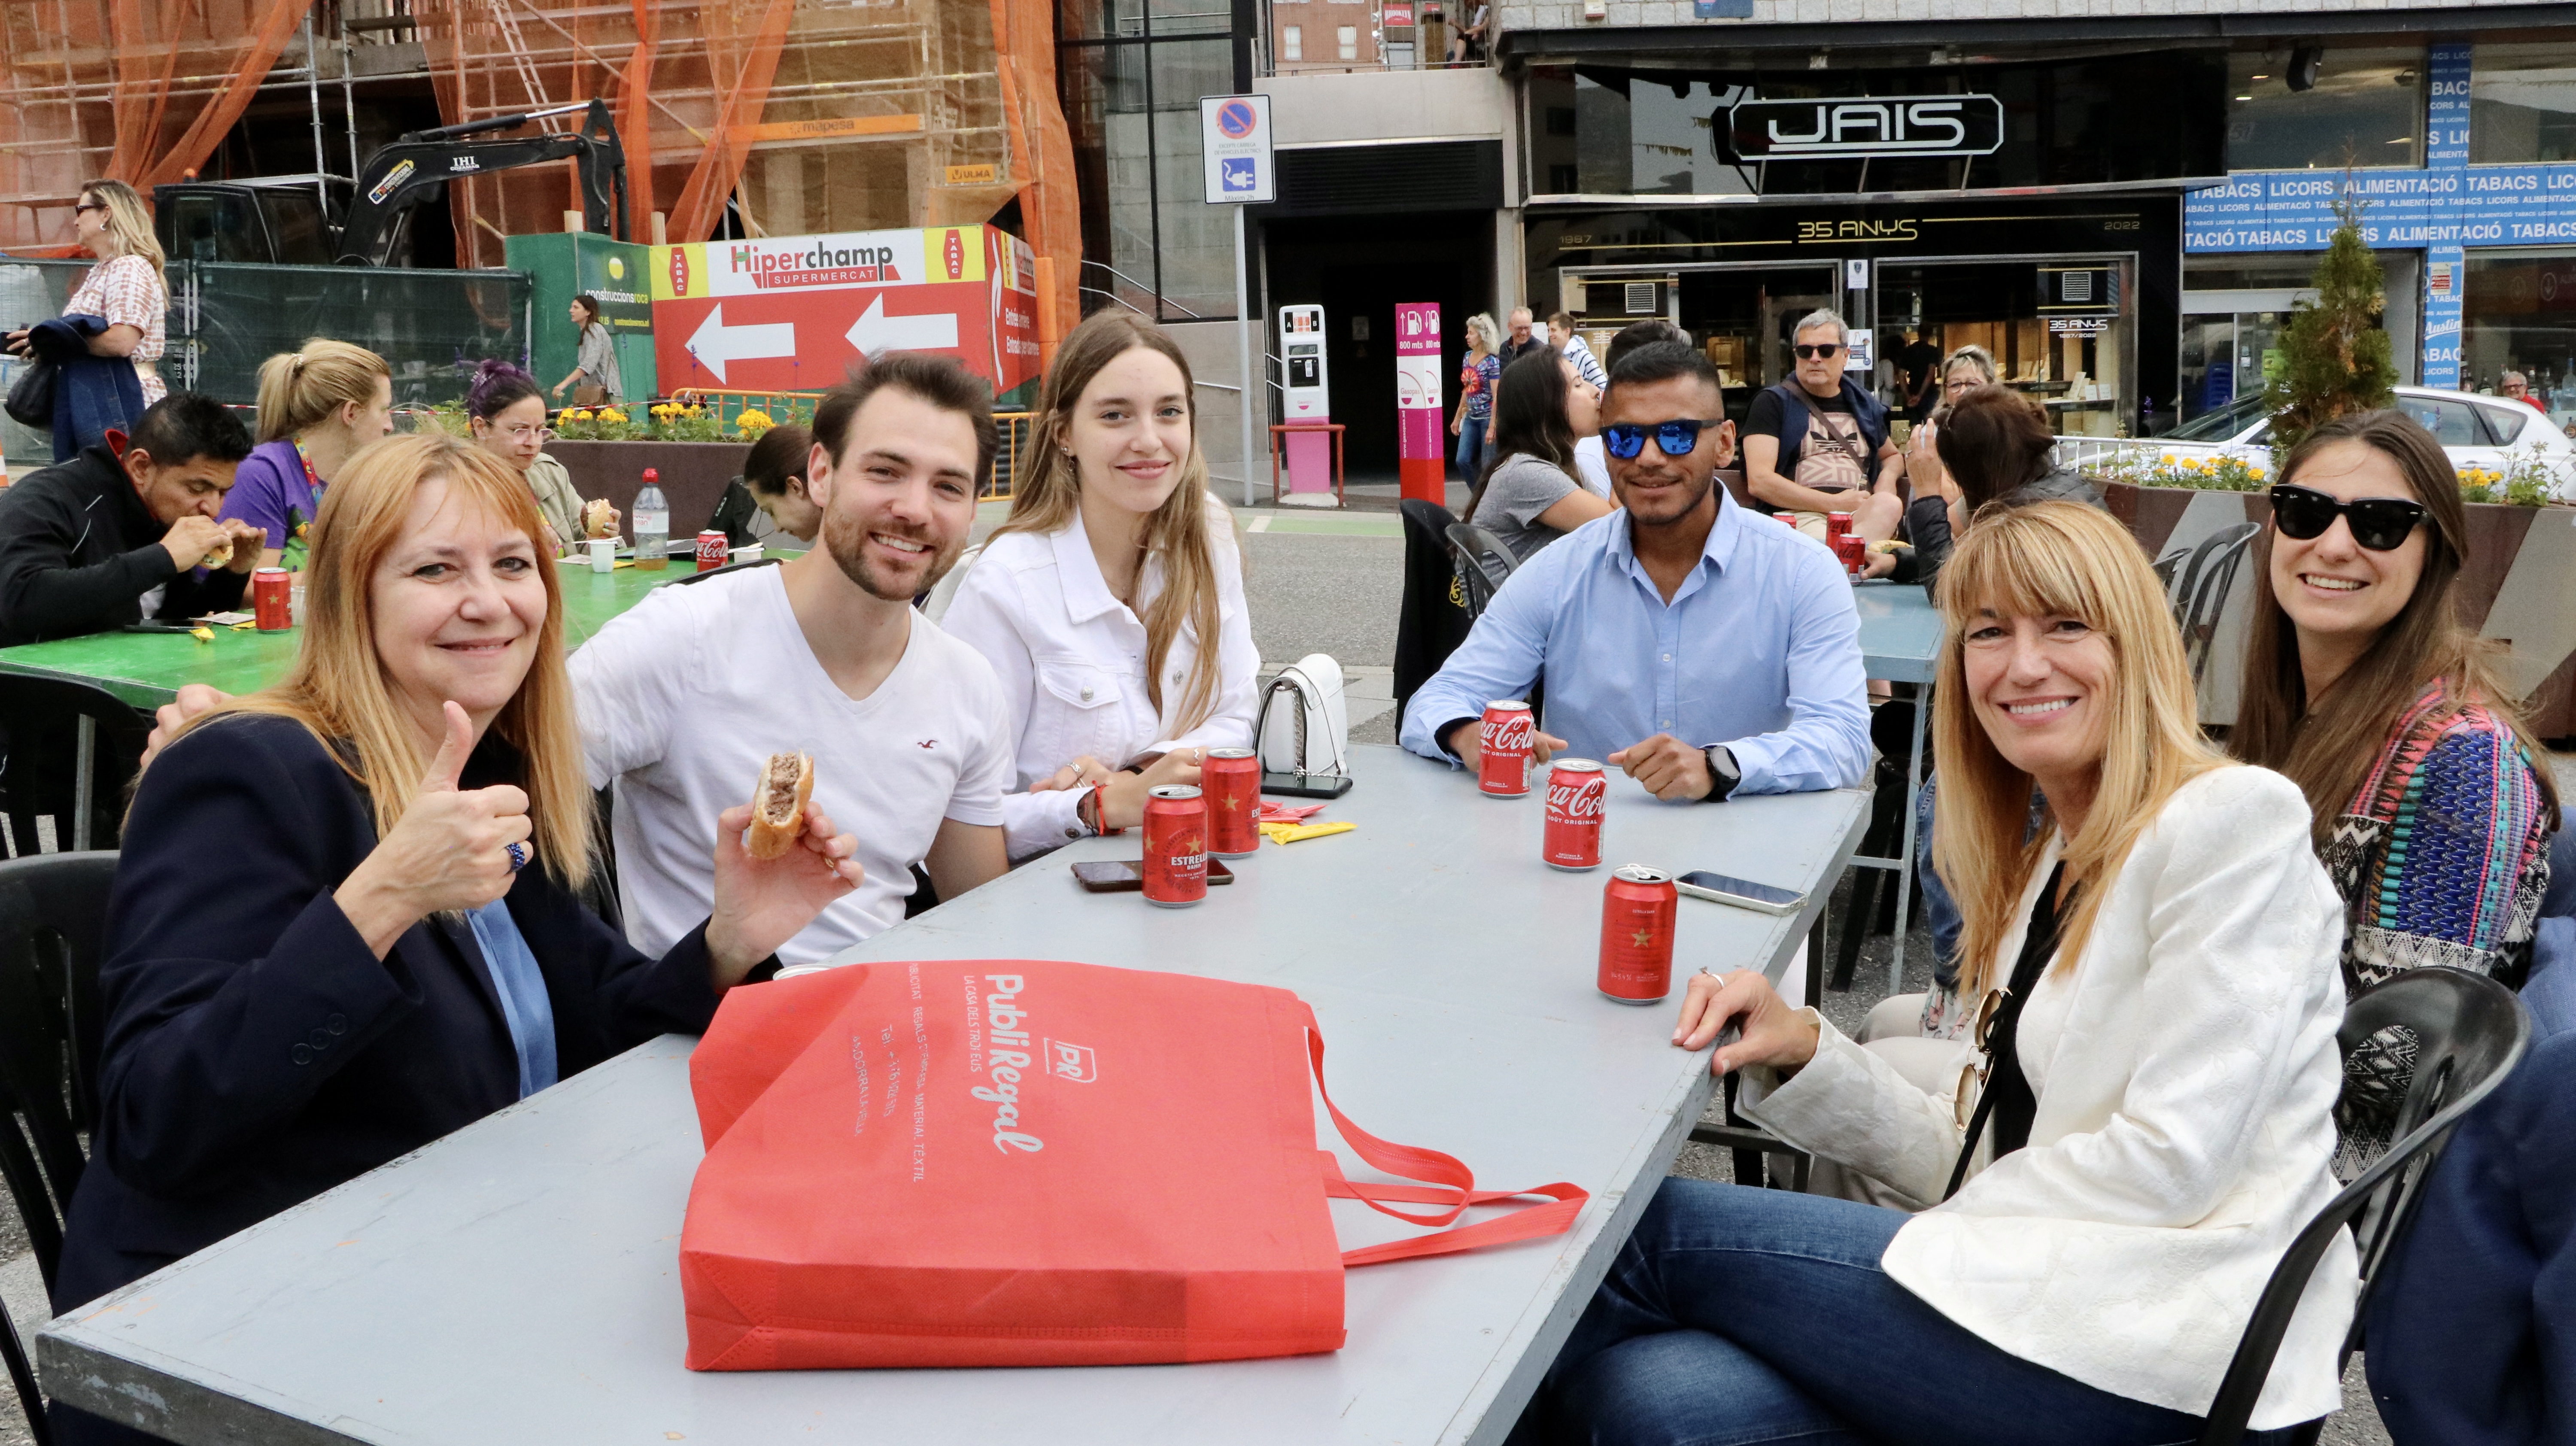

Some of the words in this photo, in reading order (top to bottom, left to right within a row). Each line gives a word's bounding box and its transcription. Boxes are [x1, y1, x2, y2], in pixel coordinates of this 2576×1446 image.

[1385, 9, 1412, 20] BROOKLYN
[2432, 80, 2470, 95] BAC
[802, 119, 855, 132] mapesa
[1768, 103, 1965, 152] JAIS
[453, 156, 475, 167] IHI
[963, 170, 990, 178] ULMA
[2270, 180, 2333, 197] LICORS
[2343, 174, 2458, 194] ALIMENTACIÓ
[2467, 175, 2538, 191] TABACS
[2548, 173, 2576, 189] LIC
[2218, 204, 2250, 212] LICORS
[2254, 200, 2311, 211] ALIMENTACIÓ
[2315, 200, 2349, 209] TABCS
[2389, 197, 2444, 207] ALIMENTACIÓ
[2448, 197, 2482, 206] TABACS
[2486, 196, 2519, 205] LICORS
[1798, 221, 1833, 238] 35
[1839, 219, 1918, 240] ANYS
[2104, 221, 2140, 230] 2022
[2237, 229, 2307, 245] TABACS
[2316, 227, 2379, 243] LIRS
[2388, 221, 2502, 241] ALIMENTACIÓ
[1559, 235, 1592, 244] 1987
[949, 237, 959, 274] TABAC
[674, 254, 684, 291] TABAC
[731, 241, 893, 289] Hiperchamp
[774, 270, 875, 284] SUPERMERCAT
[2050, 320, 2067, 329] 35
[2069, 319, 2109, 330] ANYS
[1593, 332, 1611, 341] 35
[1399, 340, 1410, 349] 800
[1412, 341, 1423, 349] mts
[1400, 388, 1420, 397] Gasopas
[1547, 815, 1562, 823] GOÛT
[964, 975, 975, 984] LA
[965, 986, 977, 1005] CASA
[913, 1006, 927, 1042] REGALS
[967, 1007, 979, 1027] DELS
[1054, 1044, 1083, 1078] PR
[913, 1094, 925, 1139] MATERIAL
